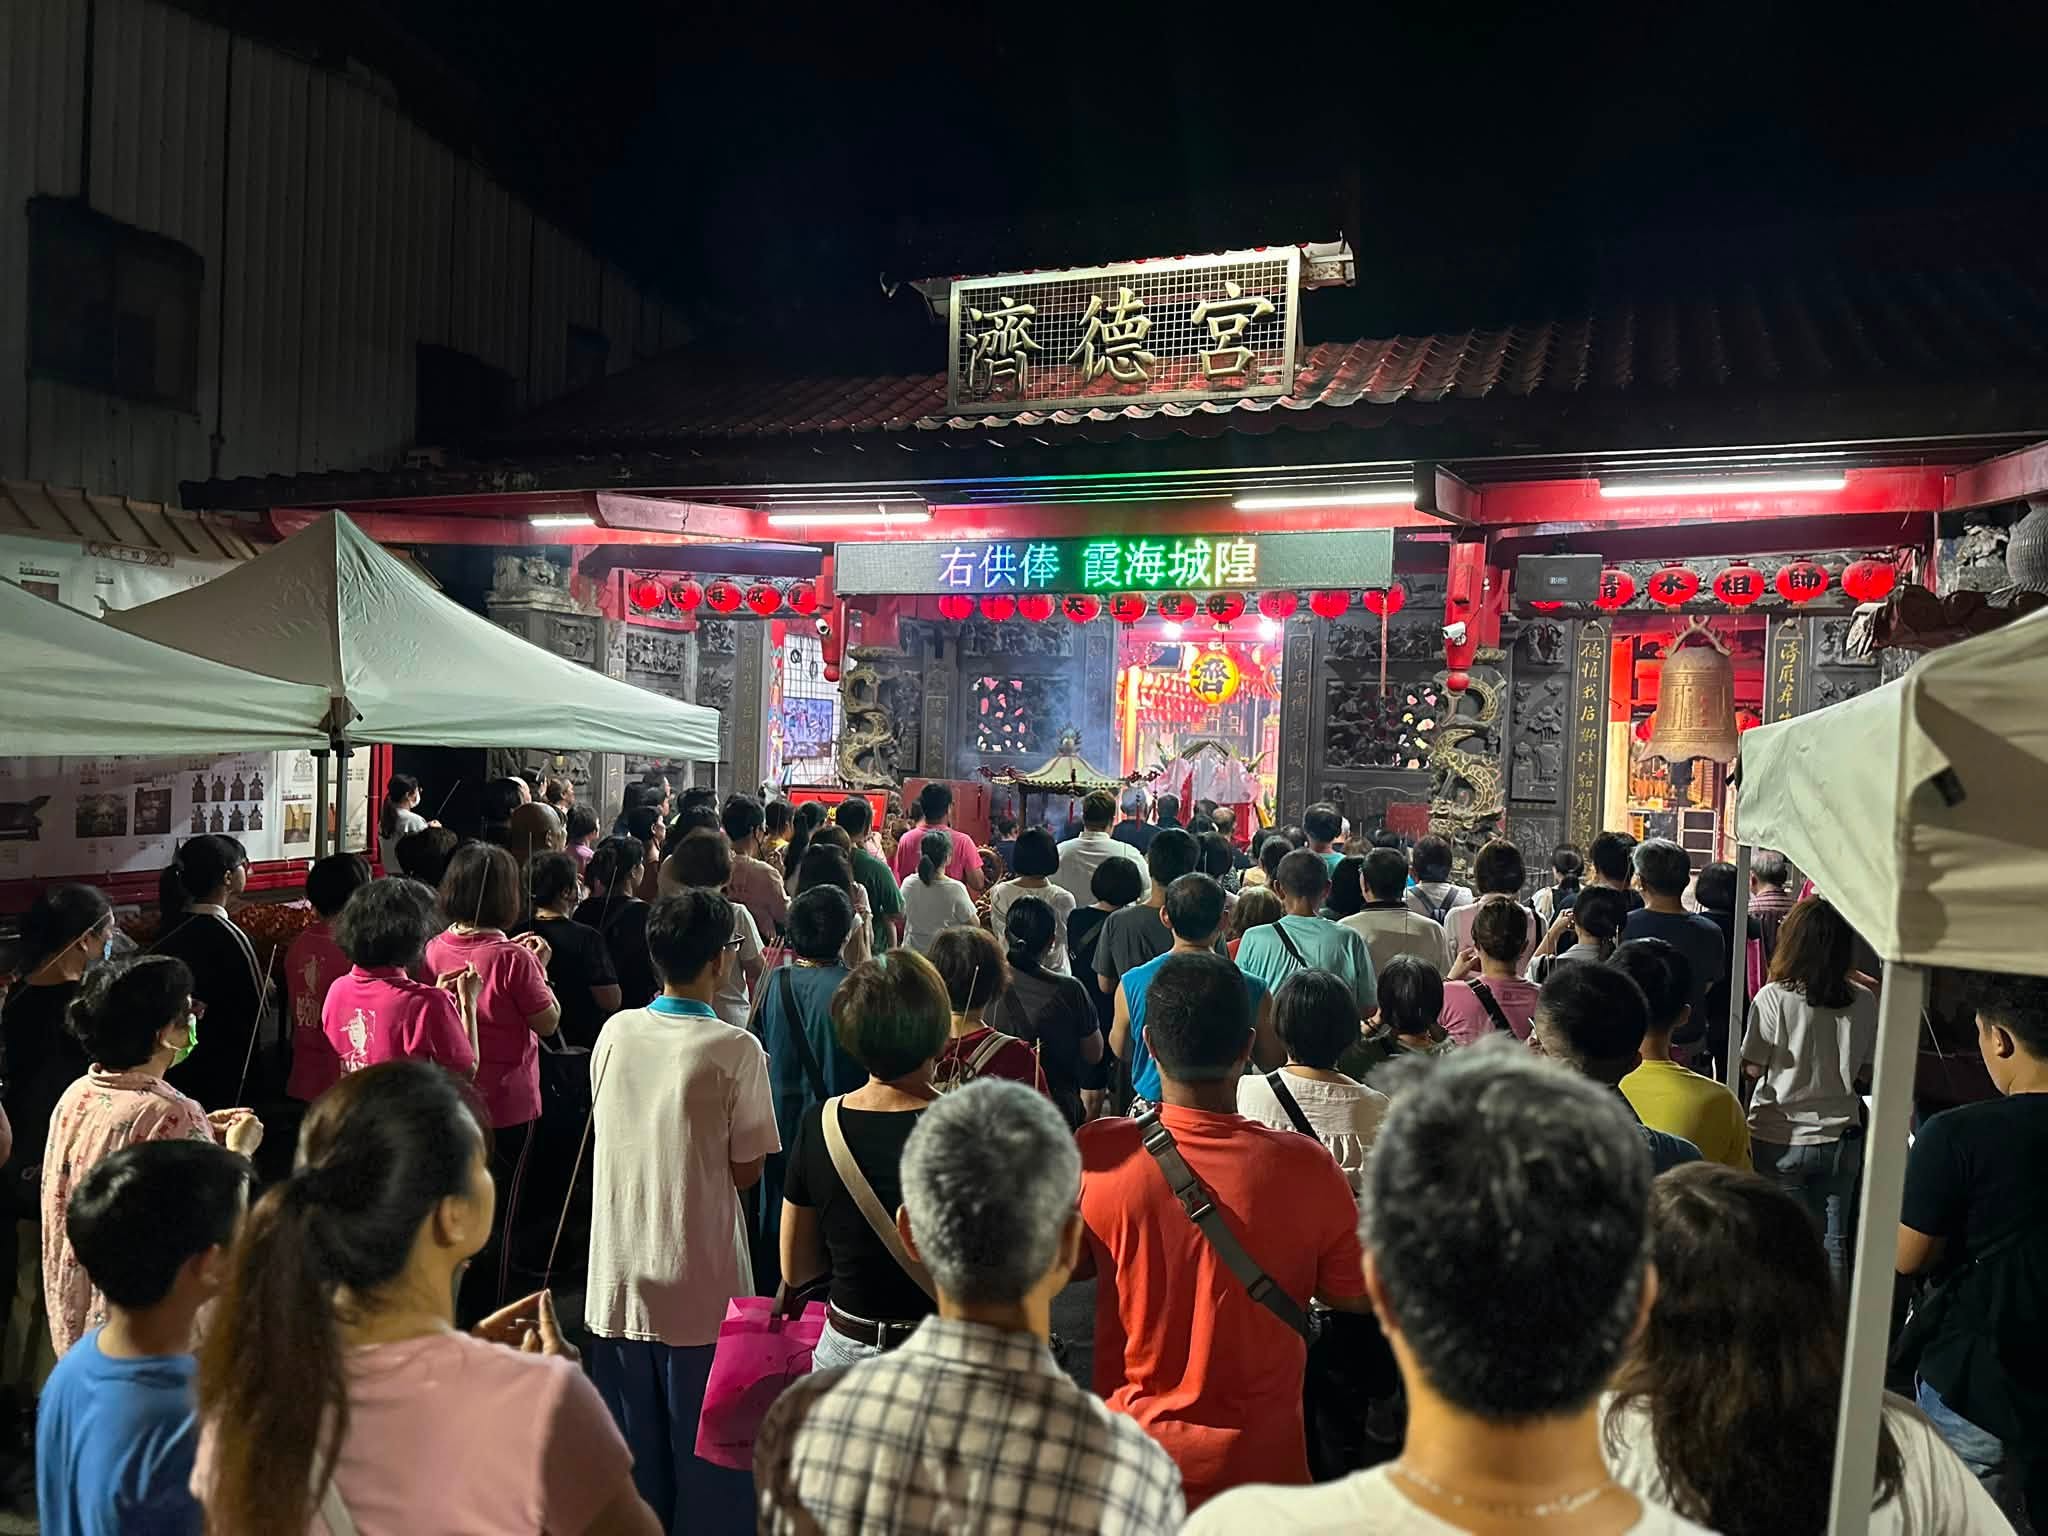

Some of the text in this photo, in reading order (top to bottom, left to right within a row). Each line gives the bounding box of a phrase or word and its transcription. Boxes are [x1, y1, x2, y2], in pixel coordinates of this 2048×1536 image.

[966, 281, 1276, 393] 濟德宮
[938, 543, 1060, 588] 右供俸
[1083, 537, 1257, 588] 霞海城隍
